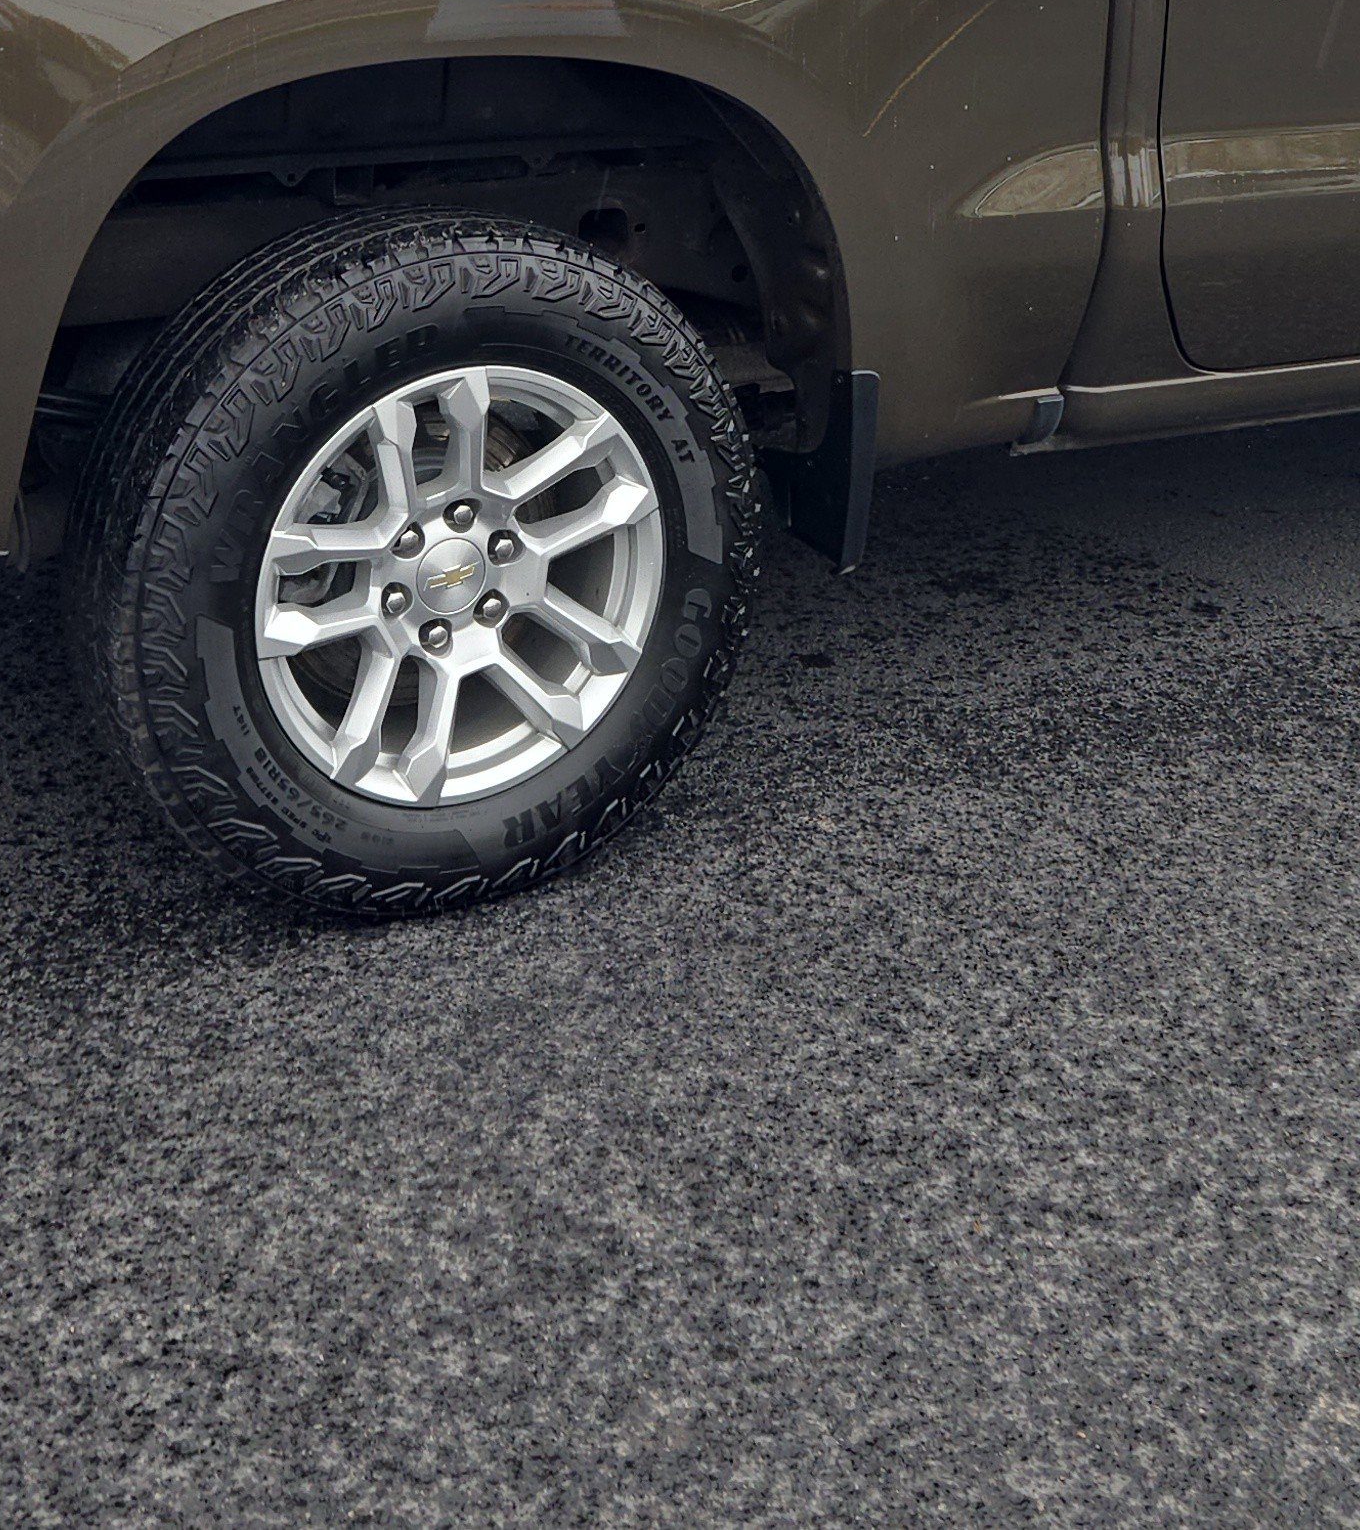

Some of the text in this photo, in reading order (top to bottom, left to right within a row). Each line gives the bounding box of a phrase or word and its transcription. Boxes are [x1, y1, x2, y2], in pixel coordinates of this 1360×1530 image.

[564, 333, 695, 463] TERRITORY AT
[502, 587, 713, 848] GOODYEAR
